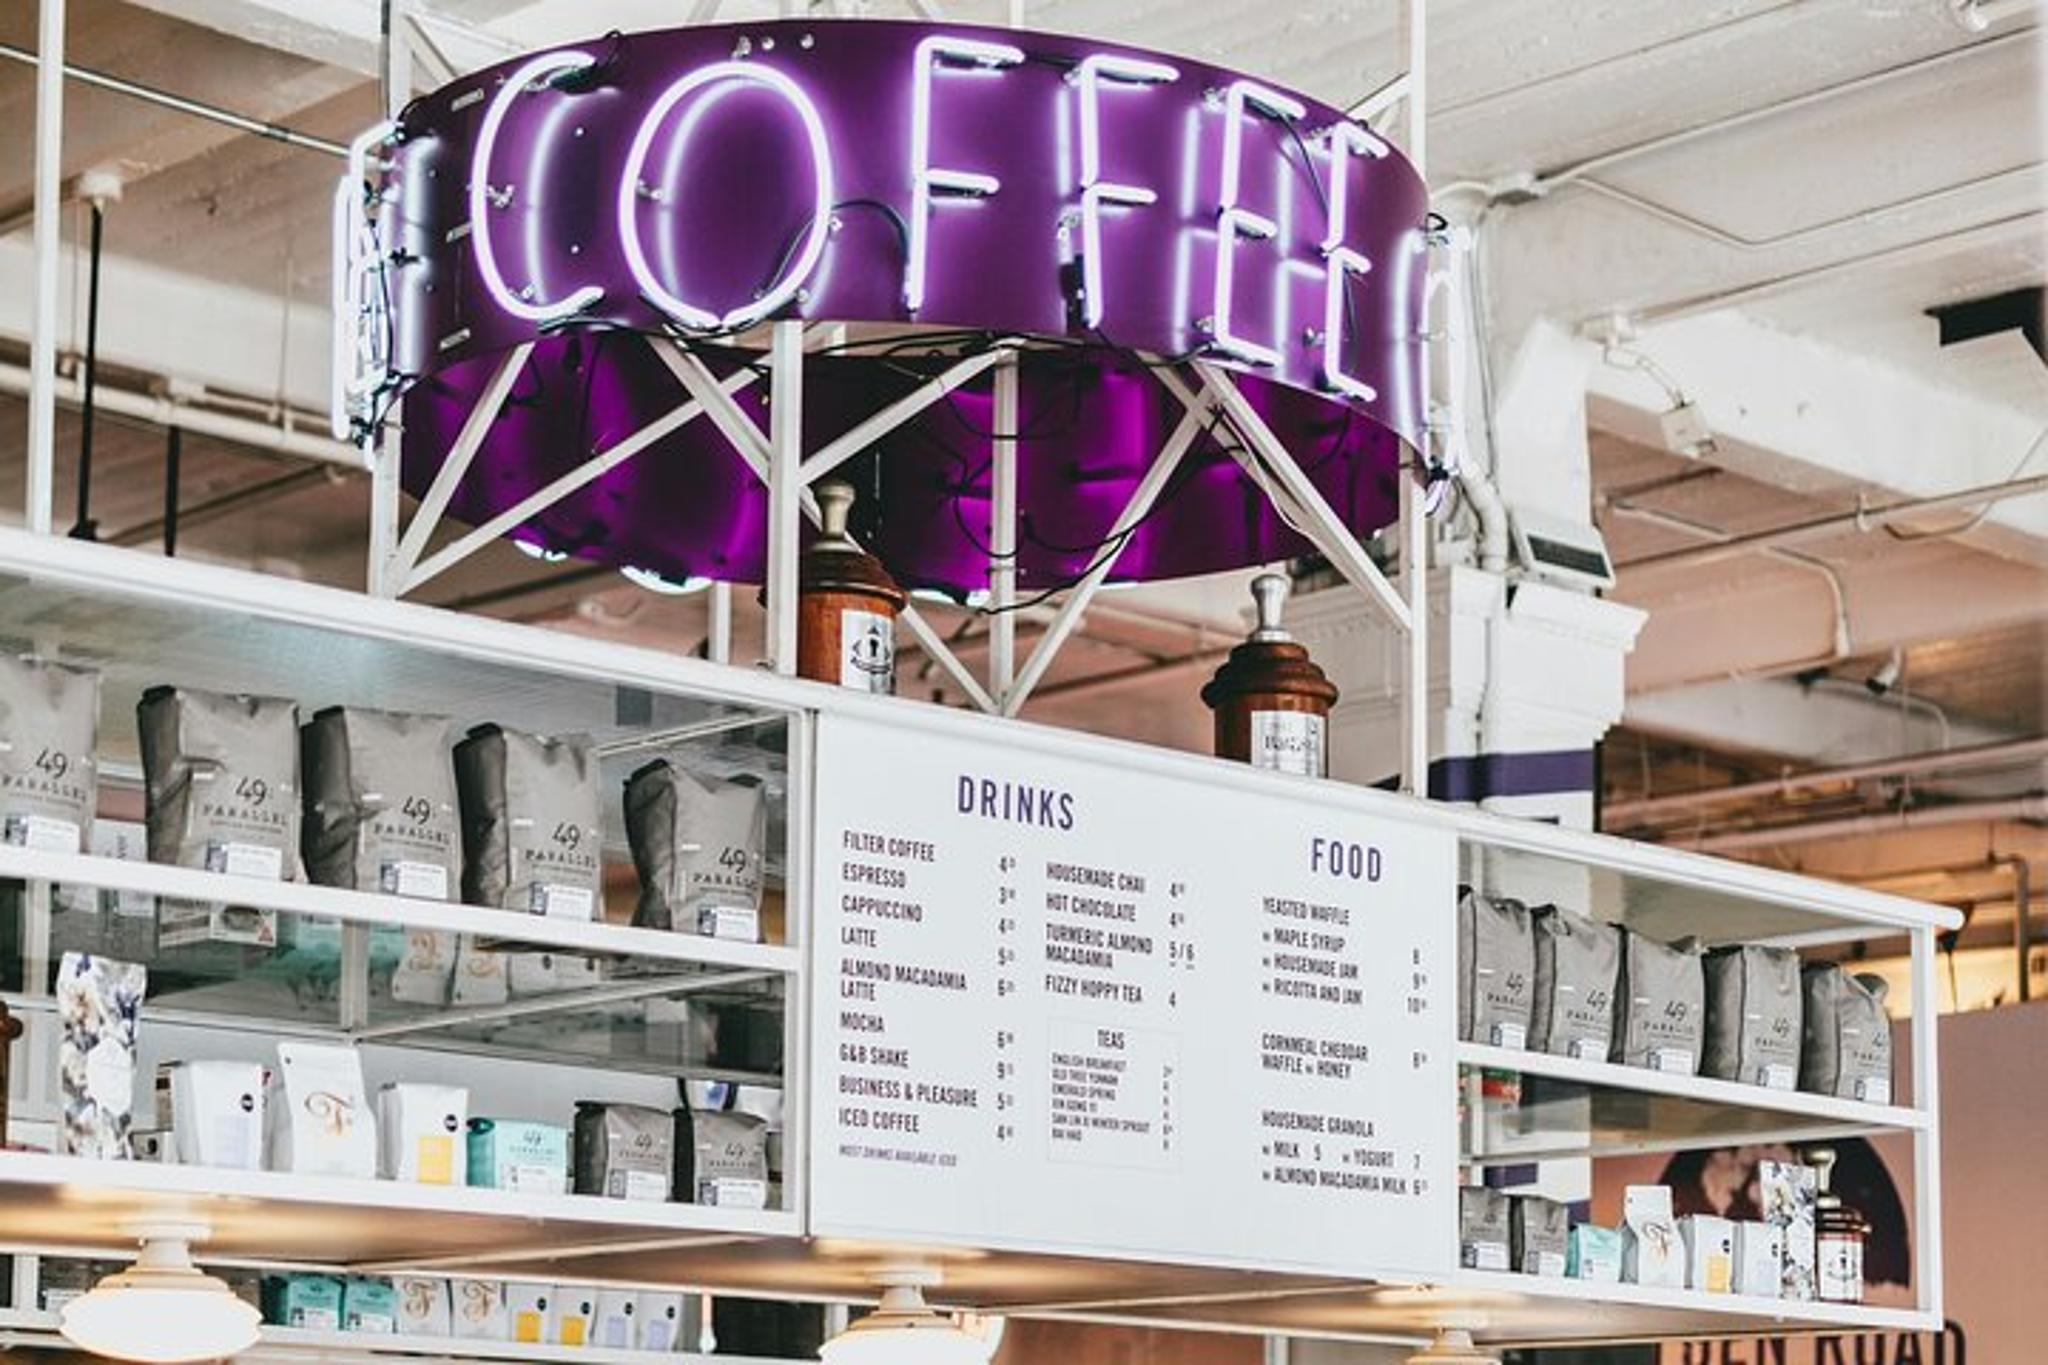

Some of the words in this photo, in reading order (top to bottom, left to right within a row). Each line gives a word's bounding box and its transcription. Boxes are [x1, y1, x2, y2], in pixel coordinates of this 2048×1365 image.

[470, 36, 1389, 401] COFFEE
[957, 775, 1075, 831] DRINKS
[843, 830, 885, 855] FILTER
[888, 836, 935, 862] COFFEE
[1311, 838, 1381, 882] FOOD
[842, 862, 906, 889] ESPRESSO
[1047, 862, 1115, 890] HOUSEMADE
[1118, 872, 1145, 894] CHAI
[842, 894, 922, 922] CAPPUCCINO
[1047, 892, 1068, 911] HOT
[1072, 896, 1136, 922] CHOCOLATE
[1263, 896, 1307, 920] YEASTED
[1310, 904, 1350, 926] WAFFLE
[841, 926, 877, 948] LATTE
[1047, 923, 1104, 948] TURMERIC
[1107, 932, 1152, 954] ALMOND
[1274, 927, 1308, 948] MAPLE
[1311, 932, 1345, 953] SYRUP
[1046, 943, 1113, 969] MACADAMIA
[1274, 953, 1336, 978] HOUSEMADE
[1340, 962, 1358, 980] JAM
[841, 957, 891, 982] ALMOND
[895, 964, 967, 991] MACADAMIA
[1046, 973, 1078, 994] FIZZY
[1081, 978, 1119, 1001] HOPPY
[1123, 983, 1143, 1003] TEA
[840, 979, 876, 1001] LATTE
[1274, 978, 1317, 1000] RICOTTA
[1320, 986, 1340, 1004] AND
[1342, 989, 1362, 1005] JAM
[840, 1011, 885, 1033] MOCHA
[1097, 1029, 1125, 1050] TEAS
[1262, 1032, 1317, 1056] CORNMEAL
[1321, 1039, 1368, 1063] CHEDDAR
[839, 1043, 867, 1064] G&B
[870, 1046, 909, 1069] SHAKE
[1262, 1054, 1303, 1076] WAFFLE
[1317, 1060, 1351, 1079] HONEY
[839, 1074, 900, 1100] BUSINESS
[916, 1083, 978, 1107] PLEASURE
[839, 1107, 868, 1128] ICED
[873, 1110, 920, 1133] COFFEE
[1262, 1110, 1325, 1133] HOUSEMADE
[1328, 1117, 1374, 1138] GRANOLA
[1274, 1141, 1300, 1159] MILK
[1354, 1149, 1394, 1168] YOGURT
[1274, 1166, 1317, 1187] ALMOND
[1320, 1170, 1380, 1191] MACADAMIA
[1382, 1177, 1407, 1195] MILK
